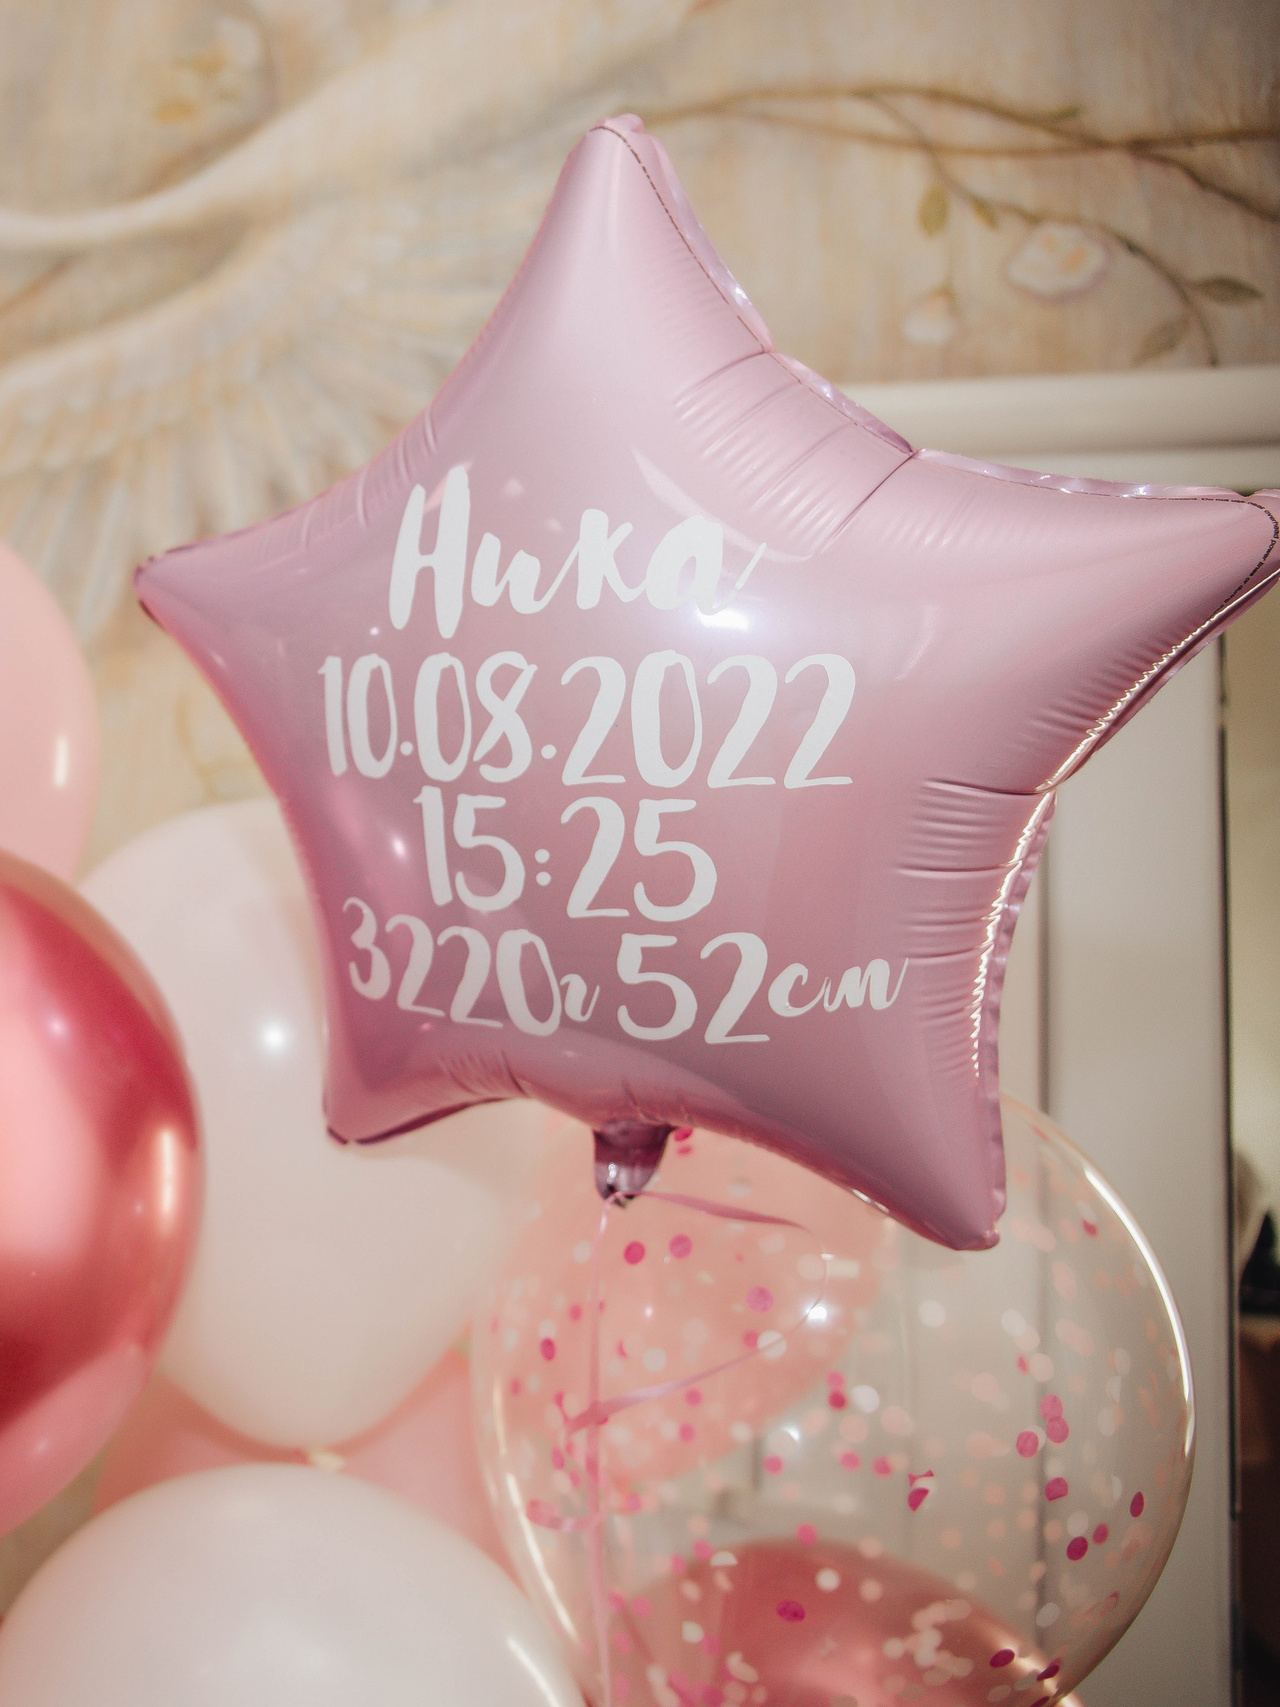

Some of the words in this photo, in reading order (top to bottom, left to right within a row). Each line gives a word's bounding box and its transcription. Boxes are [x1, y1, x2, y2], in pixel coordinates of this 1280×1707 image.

[388, 465, 768, 640] Ника
[1262, 539, 1277, 561] power
[1264, 509, 1280, 539] overhead
[318, 650, 856, 789] 10.08.2022
[413, 785, 718, 923] 15:25
